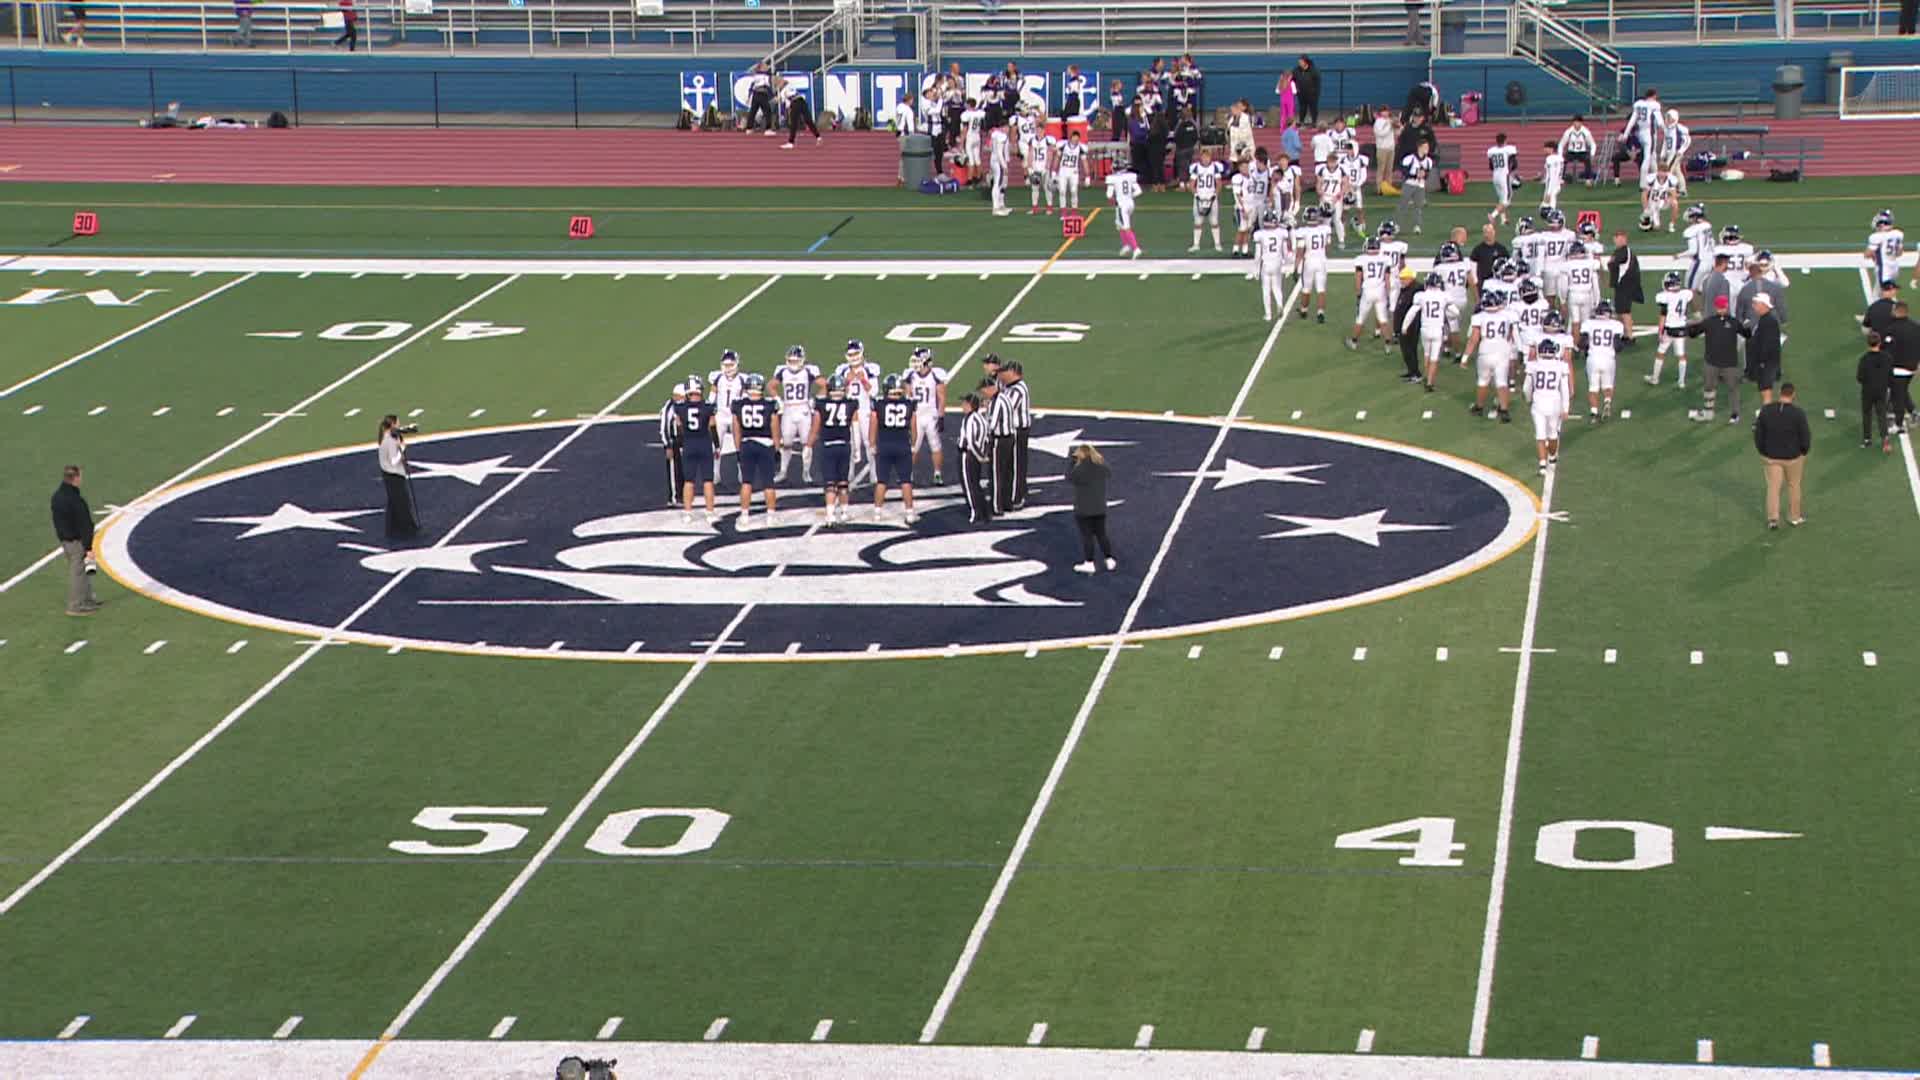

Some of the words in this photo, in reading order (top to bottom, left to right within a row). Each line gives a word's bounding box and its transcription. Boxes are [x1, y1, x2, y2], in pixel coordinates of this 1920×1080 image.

[734, 73, 1045, 124] SNIS
[1121, 180, 1130, 195] 8
[1198, 174, 1214, 189] 50
[1324, 180, 1338, 193] 77
[75, 215, 93, 231] 30
[571, 218, 588, 234] 40
[1064, 218, 1081, 234] 50
[1269, 236, 1277, 252] 2
[1312, 233, 1324, 250] 61
[1547, 240, 1565, 256] 87
[1367, 262, 1384, 278] 97
[1728, 253, 1745, 271] 53
[1447, 270, 1466, 286] 45
[1571, 268, 1590, 284] 59
[1425, 301, 1440, 318] 12
[1674, 298, 1684, 315] 4
[1520, 308, 1539, 326] 49
[1485, 320, 1506, 338] 64
[1592, 328, 1612, 346] 69
[1535, 371, 1557, 389] 82
[785, 383, 805, 400] 28
[914, 386, 930, 403] 51
[687, 407, 699, 430] 5
[741, 404, 764, 428] 65
[825, 403, 847, 426] 74
[884, 403, 907, 427] 62
[388, 806, 732, 856] 50
[1335, 816, 1674, 870] 40
